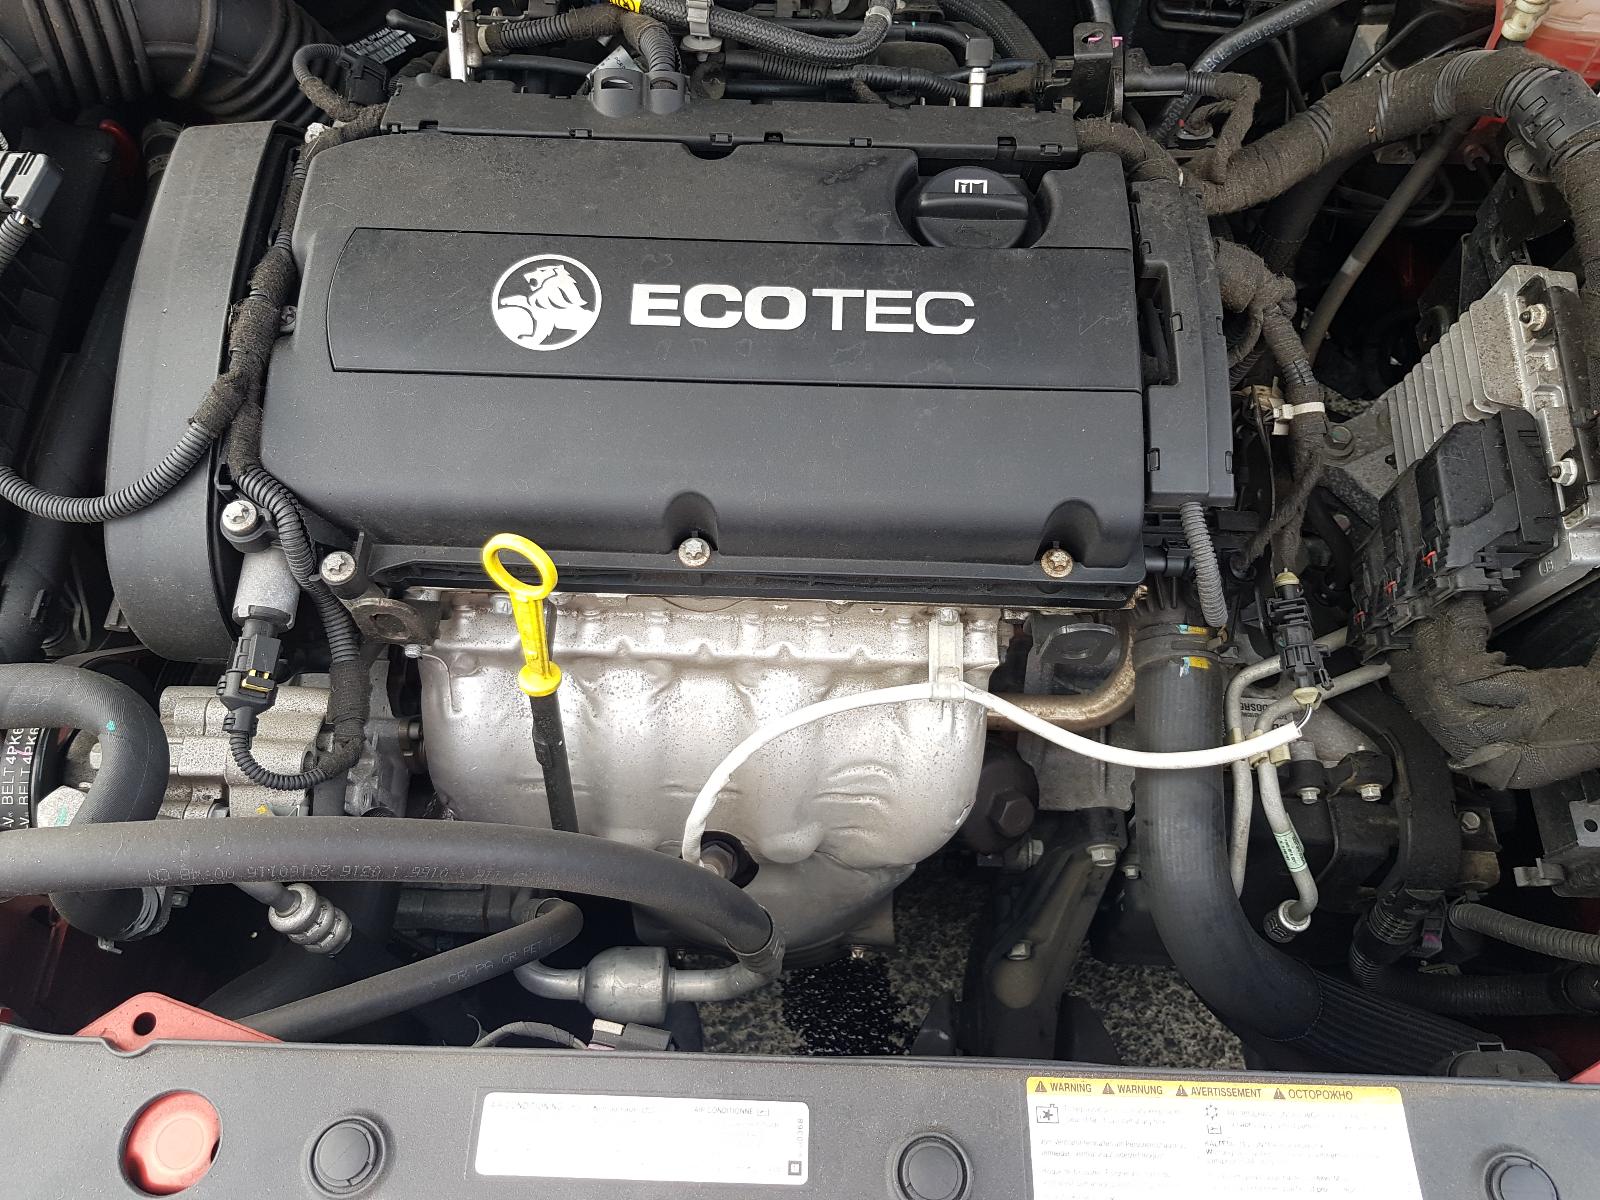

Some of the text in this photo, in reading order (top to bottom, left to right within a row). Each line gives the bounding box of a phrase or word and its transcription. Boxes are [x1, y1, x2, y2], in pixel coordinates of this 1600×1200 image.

[630, 283, 976, 335] ECOTEC
[2, 767, 15, 805] BELT
[1049, 1082, 1092, 1093] WARNING
[1117, 1084, 1163, 1095] WARNUNG
[1191, 1086, 1262, 1098] AVERTISSEMENT
[1288, 1088, 1353, 1100] ОСТОРОЖНО
